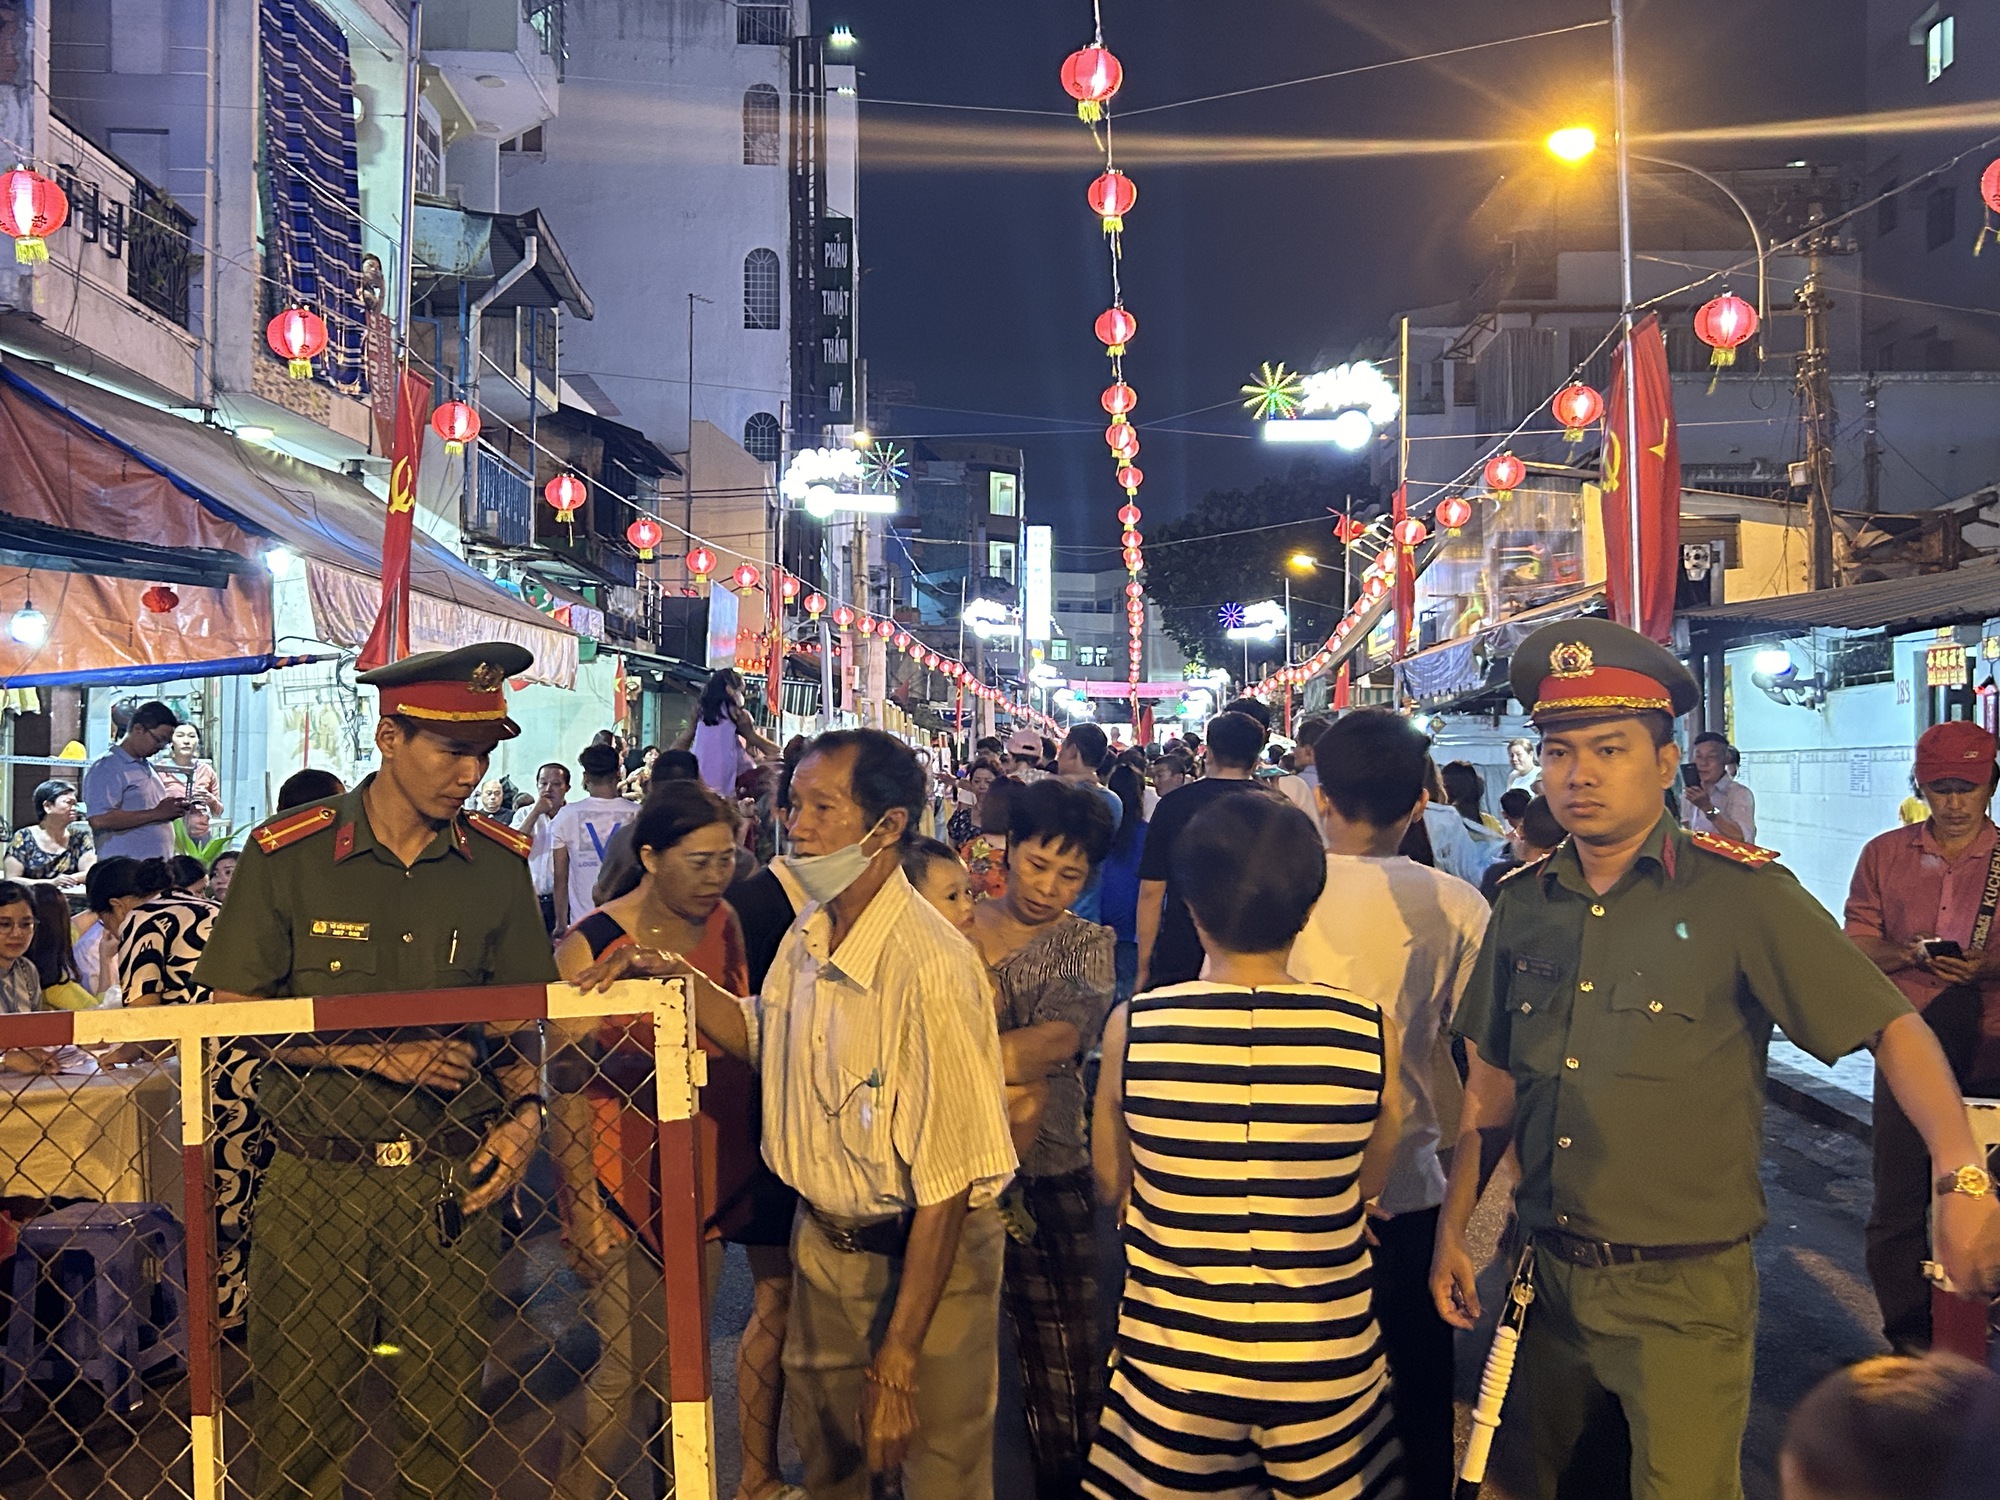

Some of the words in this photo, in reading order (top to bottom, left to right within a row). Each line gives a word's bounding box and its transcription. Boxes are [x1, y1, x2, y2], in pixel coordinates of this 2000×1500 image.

[821, 286, 849, 320] THUẬT
[829, 382, 843, 412] MỸ
[585, 822, 622, 863] V
